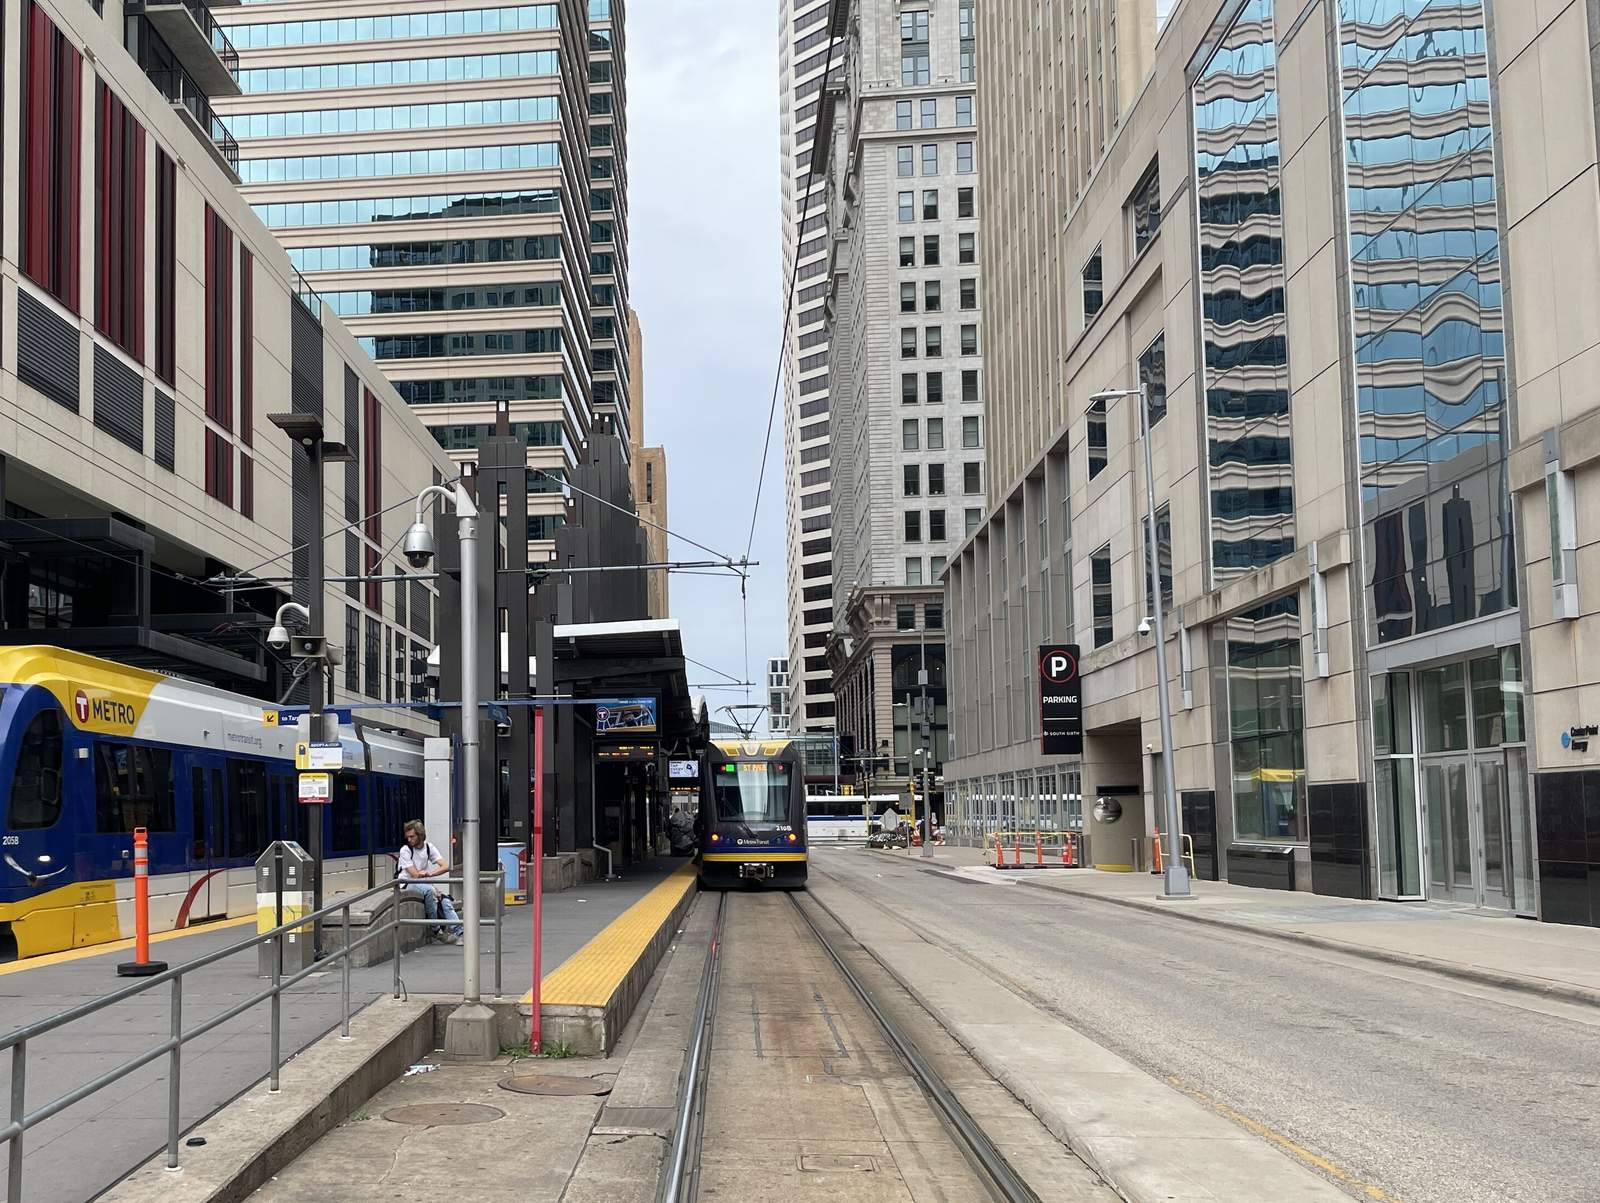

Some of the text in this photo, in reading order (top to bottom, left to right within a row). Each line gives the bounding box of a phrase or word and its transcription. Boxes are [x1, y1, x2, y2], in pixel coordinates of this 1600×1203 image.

[1051, 656, 1067, 678] P
[1043, 695, 1078, 704] PARKING
[92, 697, 135, 726] METRO
[2, 835, 20, 846] 2058
